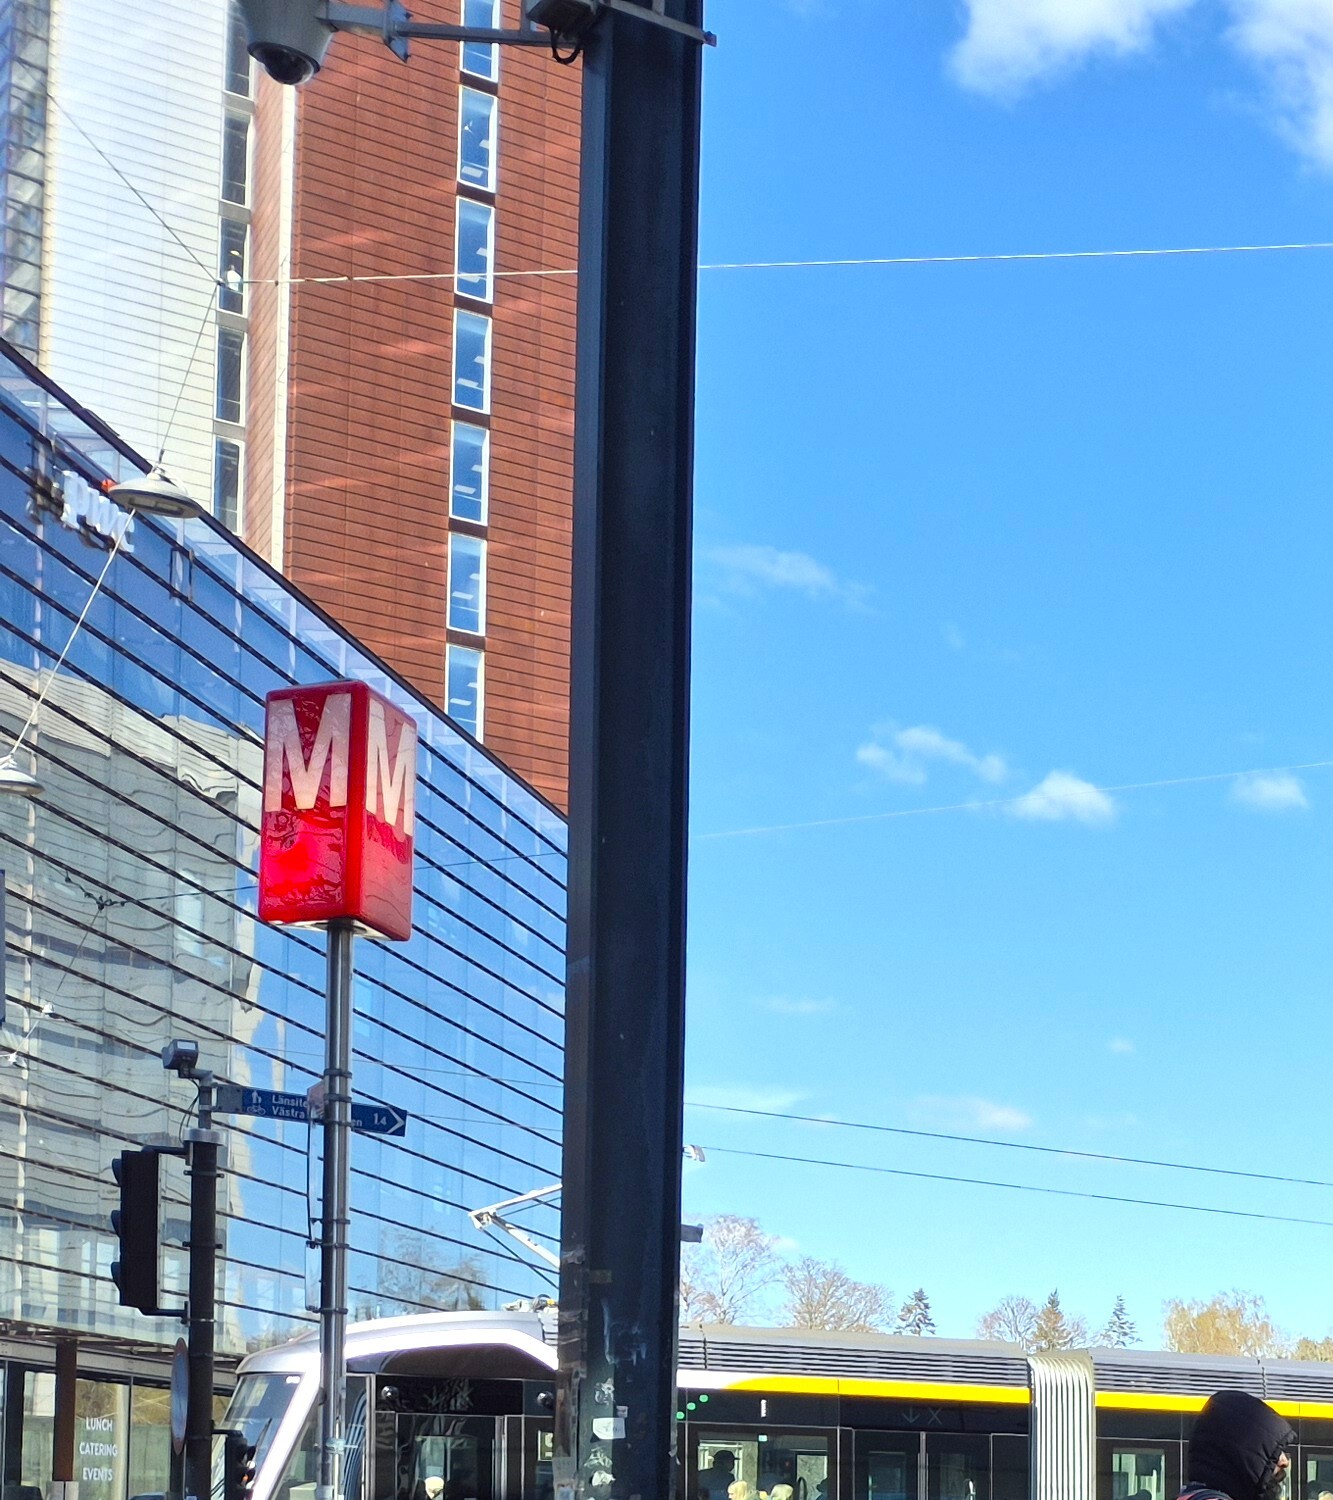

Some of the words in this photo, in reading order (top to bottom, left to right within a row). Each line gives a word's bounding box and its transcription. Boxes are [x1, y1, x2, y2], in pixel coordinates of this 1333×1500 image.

[60, 469, 135, 553] pwc
[264, 692, 351, 813] M
[365, 697, 417, 838] M
[272, 1105, 305, 1119] Västra
[86, 1417, 112, 1431] LUNCH
[79, 1442, 118, 1457] CATERING
[82, 1467, 113, 1481] EVENTS
